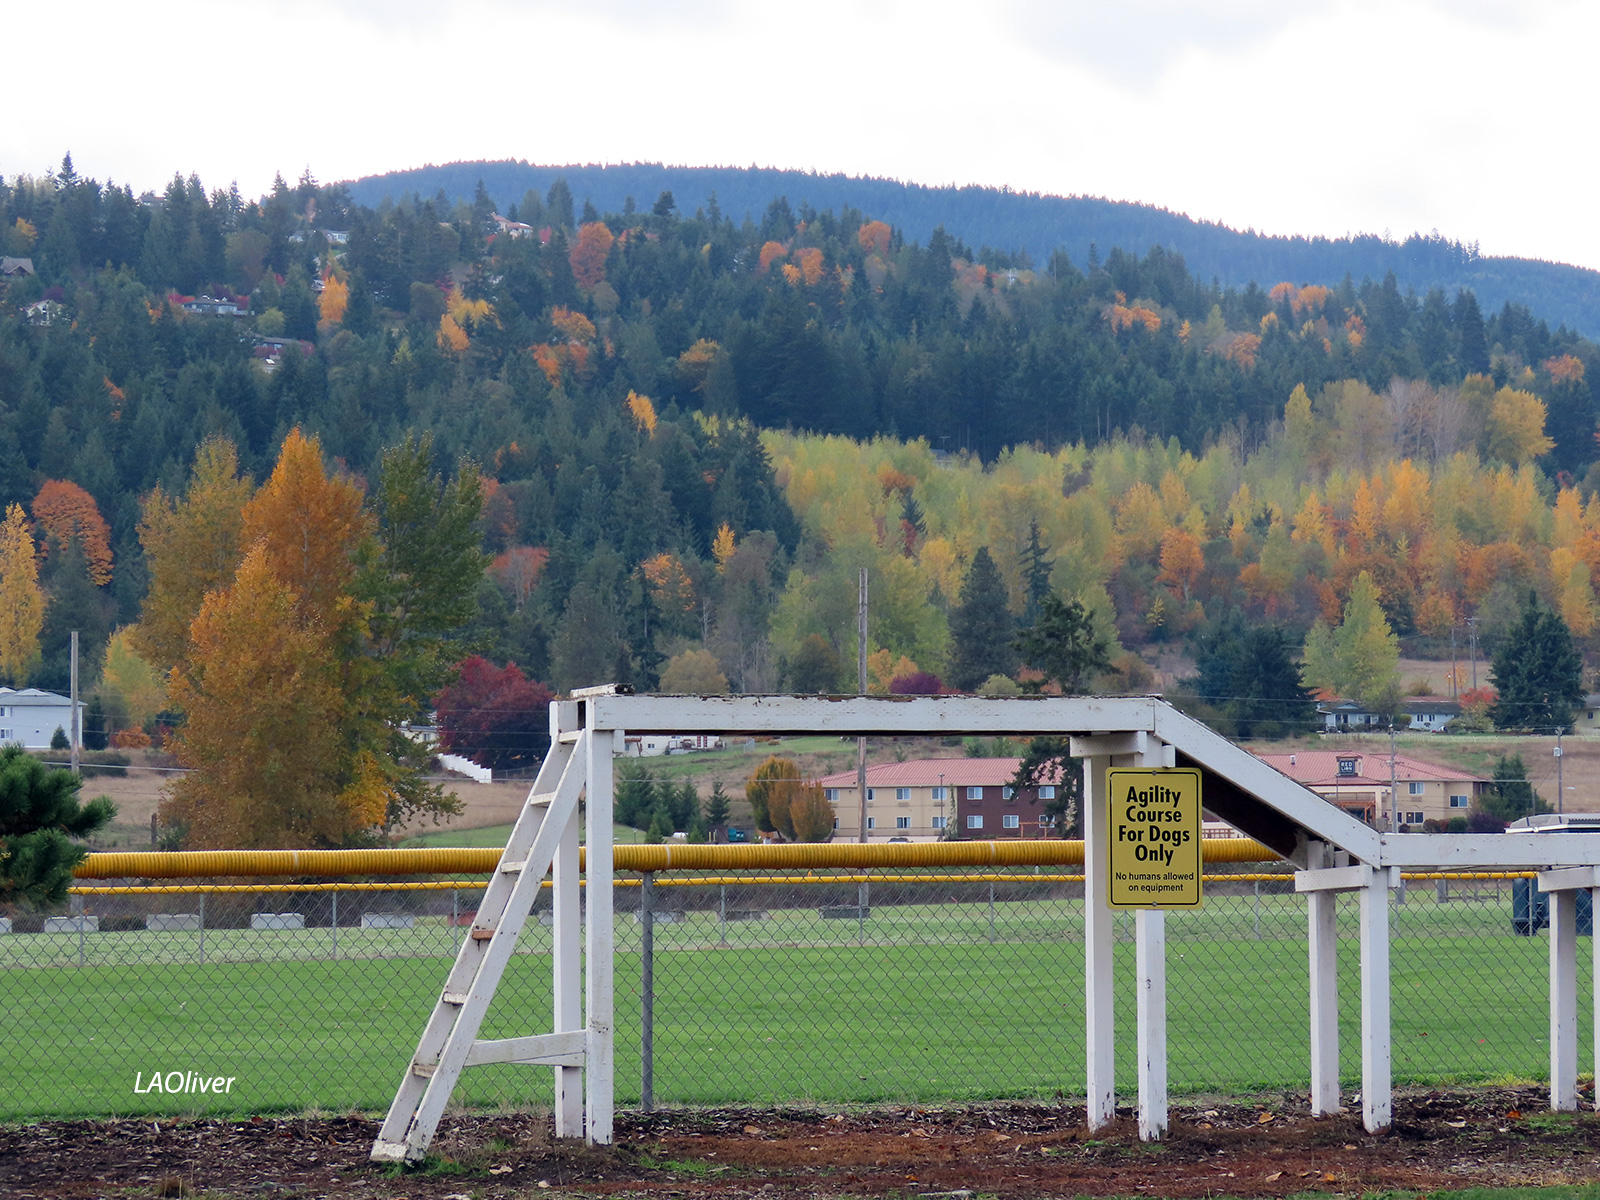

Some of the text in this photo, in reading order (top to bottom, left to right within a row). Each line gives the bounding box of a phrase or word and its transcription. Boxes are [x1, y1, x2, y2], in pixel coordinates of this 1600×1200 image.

[1126, 785, 1181, 808] Agility
[1126, 806, 1182, 822] Course
[1118, 825, 1190, 847] For Dogs
[1135, 844, 1174, 866] Only
[1129, 872, 1161, 880] humans
[1163, 872, 1194, 880] allowed
[1141, 884, 1184, 893] equipment
